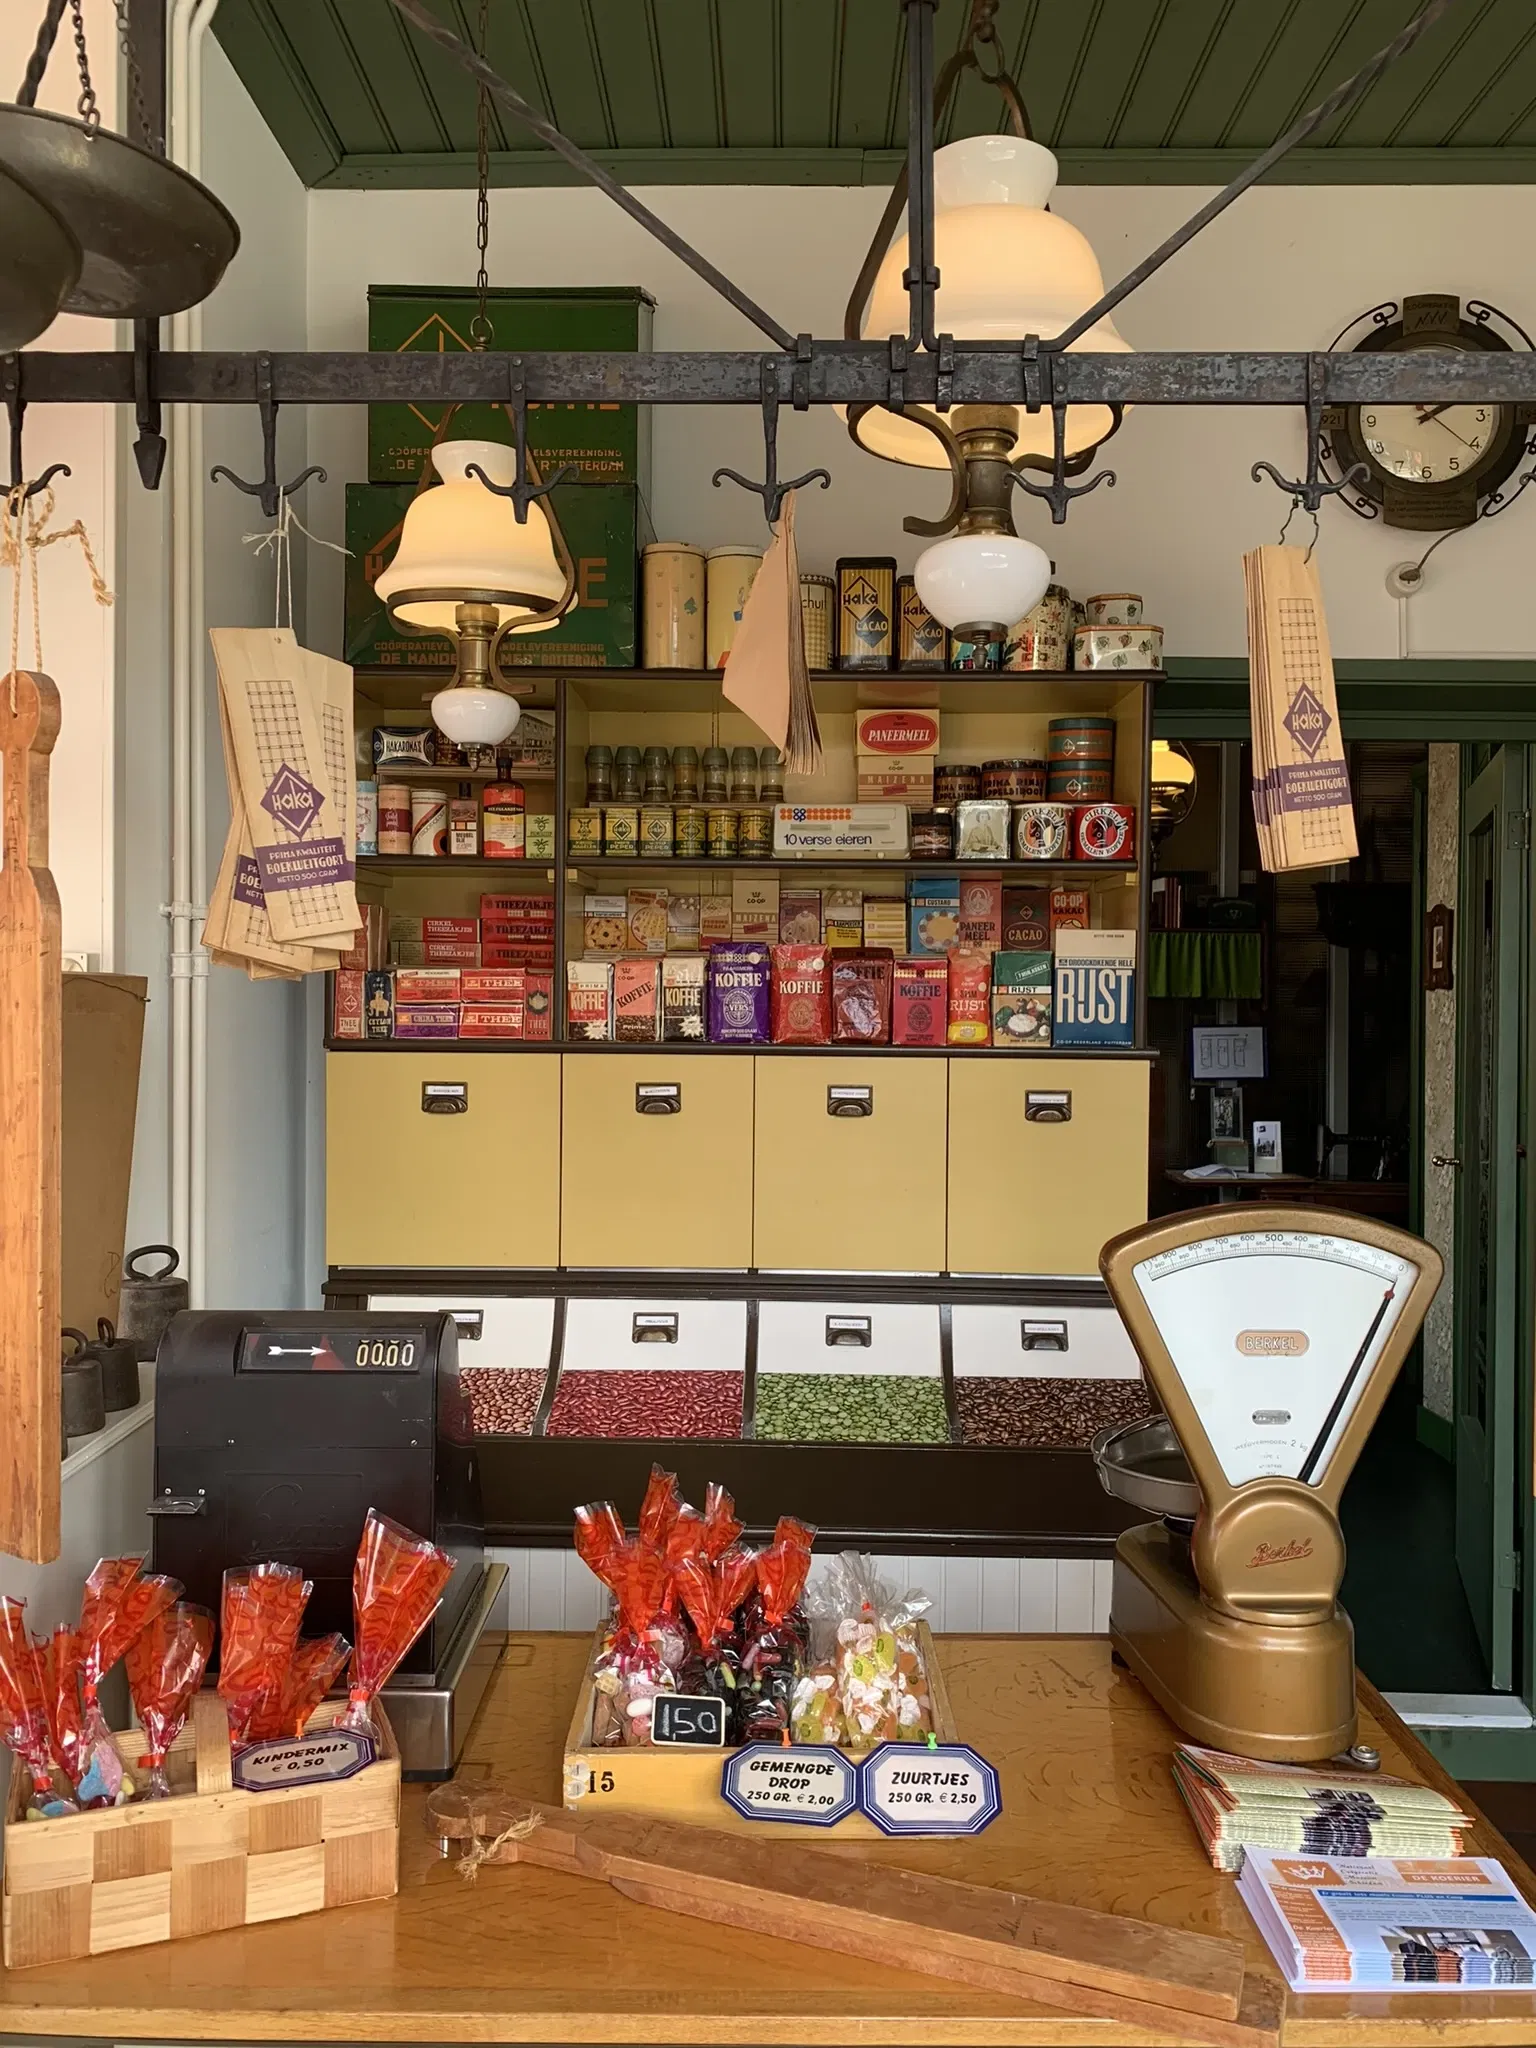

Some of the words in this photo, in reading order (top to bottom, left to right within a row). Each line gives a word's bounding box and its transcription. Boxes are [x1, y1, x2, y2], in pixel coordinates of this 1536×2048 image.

[1366, 415, 1377, 427] 9
[1476, 409, 1485, 421] 3
[1469, 436, 1480, 449] 4
[1395, 461, 1404, 473] 7
[1449, 458, 1459, 470] 5
[1422, 466, 1432, 478] 6
[856, 621, 888, 632] CACAO
[868, 729, 931, 742] PANEERMEEL
[1289, 769, 1310, 779] PRIMA
[1310, 767, 1340, 778] KWALITEIT
[867, 775, 925, 785] MAIZENA
[1286, 777, 1347, 794] BOEKWEITGORT
[1294, 794, 1312, 803] NETTO
[1327, 791, 1342, 800] GRAM
[1022, 807, 1058, 822] CIRKEL
[1084, 806, 1119, 821] CIRKEL
[784, 834, 797, 845] 10
[798, 835, 832, 846] verse
[835, 833, 872, 846] eieren
[1080, 830, 1105, 856] GEMALEN
[269, 848, 297, 860] PRIMA
[297, 844, 337, 857] KWALITEIT
[266, 853, 344, 875] BOEKWEITGORT
[277, 873, 301, 884] NETTO
[319, 868, 339, 879] GRAM
[245, 888, 266, 900] NETT
[496, 900, 554, 910] THEEZAKJE
[1053, 907, 1084, 915] KAKAO
[735, 913, 776, 923] MAIZENA
[496, 925, 554, 935] THEEZAKJE
[960, 922, 995, 932] PANEER
[965, 931, 990, 941] MEEL
[1008, 930, 1042, 941] CACAO
[1118, 959, 1133, 967] HELE
[482, 979, 523, 987] THEE
[715, 973, 762, 987] KOFFIE
[780, 981, 824, 994] KOFFIE
[900, 985, 941, 998] KOFFIE
[570, 992, 605, 1010] KOFFIE
[616, 981, 655, 1009] KOFFIE
[666, 987, 701, 1007] KOFFIE
[1056, 969, 1133, 1024] RIJST
[728, 1004, 749, 1012] VERS
[950, 1000, 987, 1011] RIJST
[368, 1018, 391, 1026] CEYLON
[413, 1015, 434, 1023] CHINA
[481, 1015, 522, 1023] THEE
[529, 1020, 547, 1029] THEE
[1215, 1237, 1228, 1245] 700
[1265, 1233, 1284, 1241] 500
[1187, 1243, 1203, 1251] 800
[1346, 1244, 1360, 1252] 200
[1162, 1250, 1177, 1259] 900
[1245, 1336, 1299, 1350] BERKEL
[1290, 1439, 1297, 1448] 2
[1245, 1537, 1314, 1569] Berkel
[661, 1703, 717, 1741] 1,50
[252, 1743, 349, 1766] KINDERMIX
[272, 1764, 283, 1773] €
[287, 1757, 324, 1770] 0,50
[750, 1761, 835, 1776] GEMENGDE
[588, 1771, 615, 1793] 15
[768, 1776, 810, 1789] DROP
[891, 1771, 970, 1786] ZUURTJES
[747, 1790, 770, 1800] 250
[773, 1792, 792, 1803] GR.
[797, 1794, 805, 1803] €
[807, 1794, 834, 1806] 2,00
[888, 1792, 912, 1803] 250
[915, 1793, 935, 1804] GR.
[939, 1793, 947, 1803] €
[950, 1793, 977, 1805] 2,50
